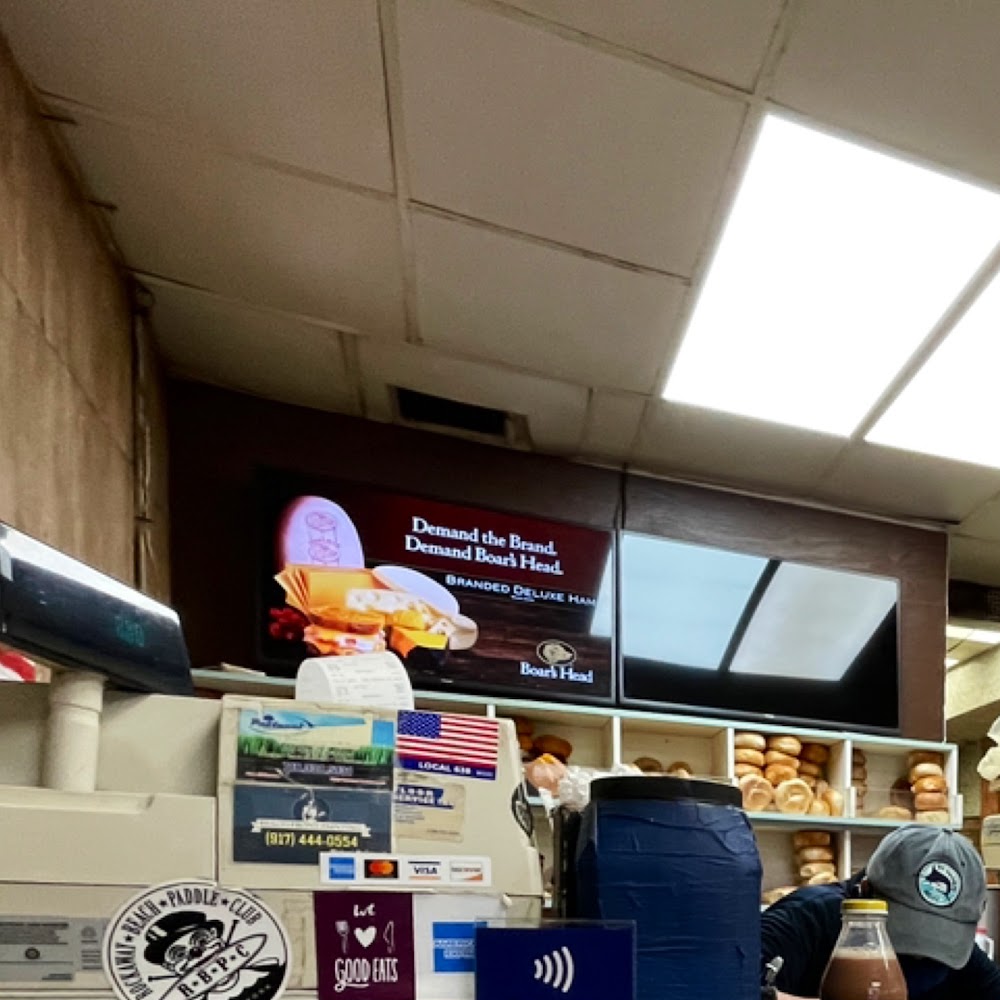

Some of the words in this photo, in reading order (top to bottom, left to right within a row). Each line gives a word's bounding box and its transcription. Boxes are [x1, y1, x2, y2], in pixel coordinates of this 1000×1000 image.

[411, 515, 478, 544] Demand
[481, 531, 506, 548] the
[508, 533, 558, 556] Brand.
[404, 534, 471, 561] Demand
[475, 546, 517, 568] Boar's
[519, 554, 564, 576] Head.
[444, 573, 511, 594] BRANDED
[519, 661, 558, 680] Boar's
[559, 667, 594, 684] Head
[417, 761, 452, 774] LOCAL
[265, 832, 295, 848] (917)
[299, 832, 358, 848] 444-0554
[121, 900, 162, 936] BEACH
[166, 888, 221, 908] PADDLE
[228, 898, 263, 926] CLUB
[335, 958, 371, 992] GOOD
[372, 958, 398, 983] EATS
